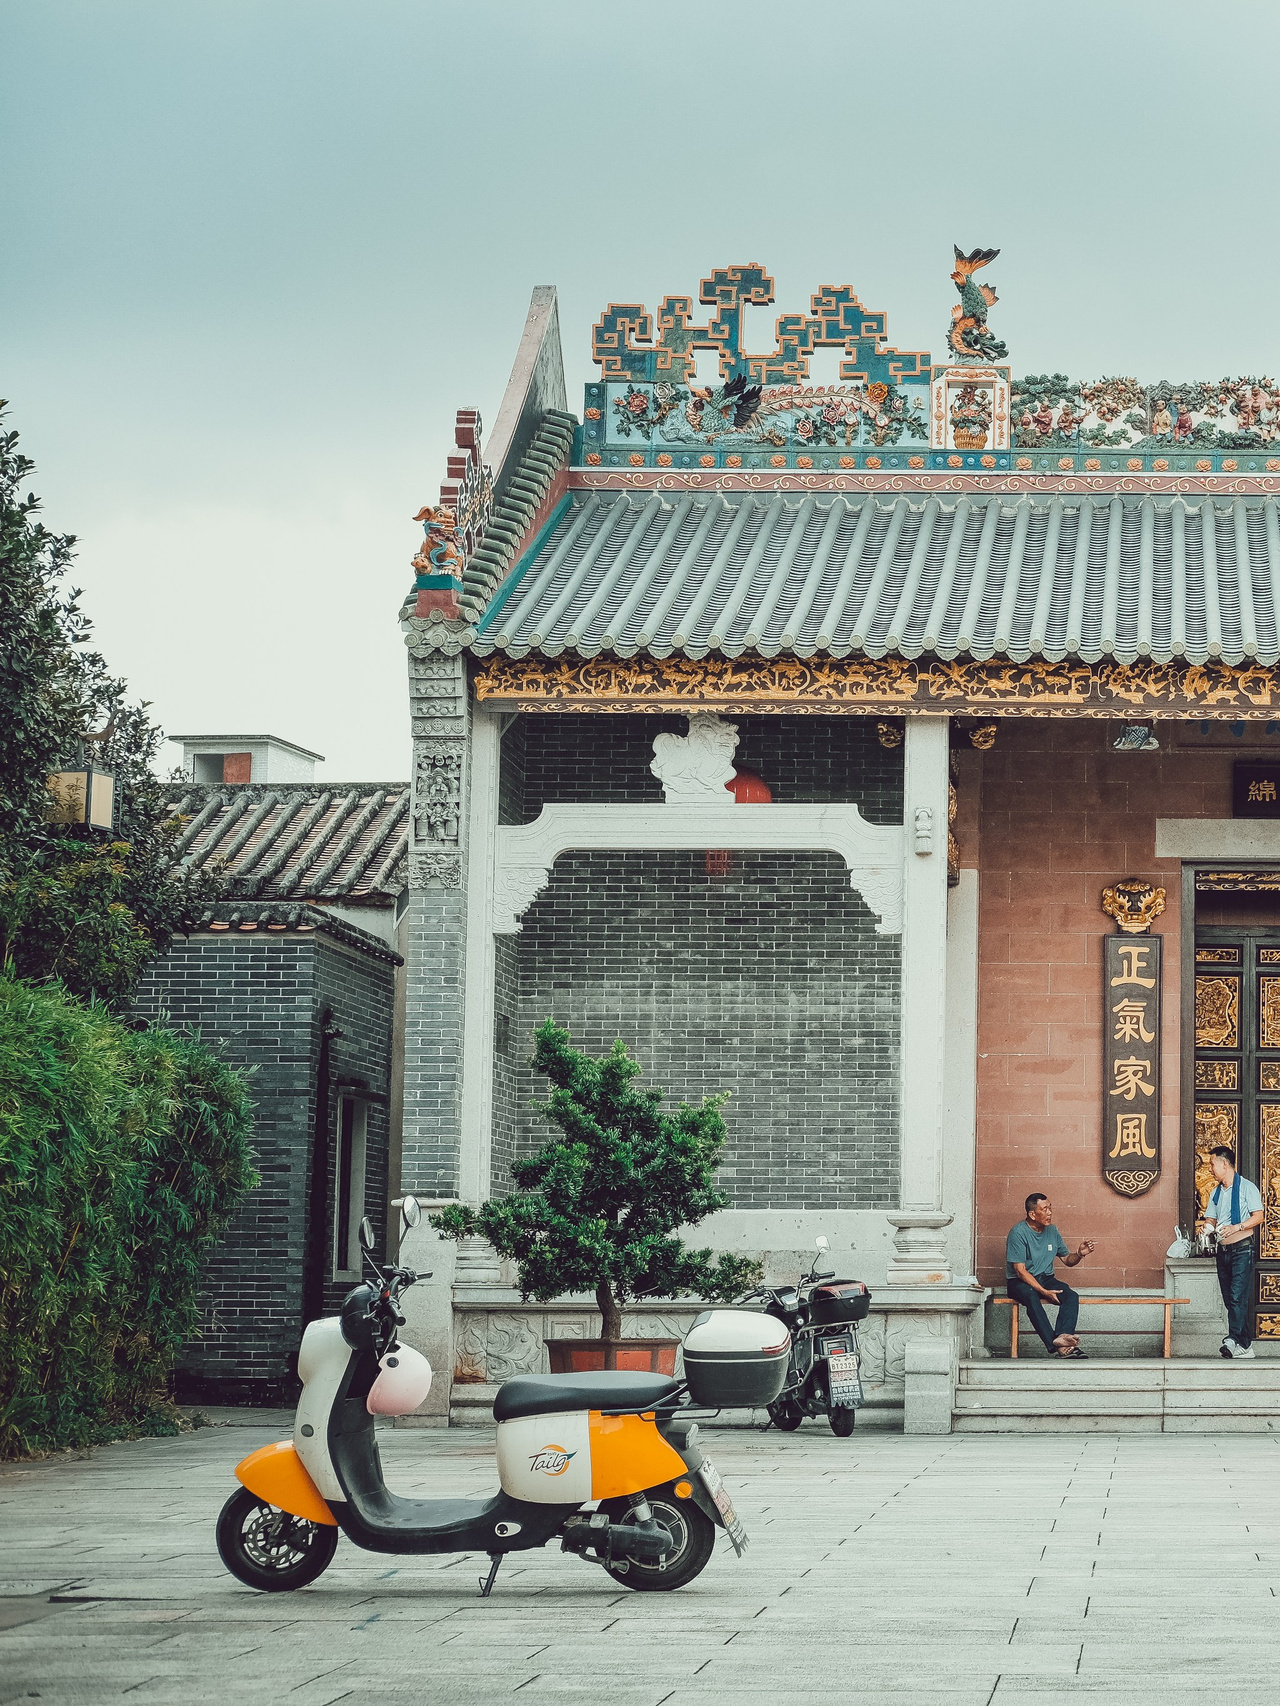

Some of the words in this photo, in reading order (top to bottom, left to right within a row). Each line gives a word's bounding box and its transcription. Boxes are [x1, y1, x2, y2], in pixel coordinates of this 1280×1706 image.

[1108, 945, 1156, 1158] 正氣家風
[528, 1451, 570, 1472] Tailg
